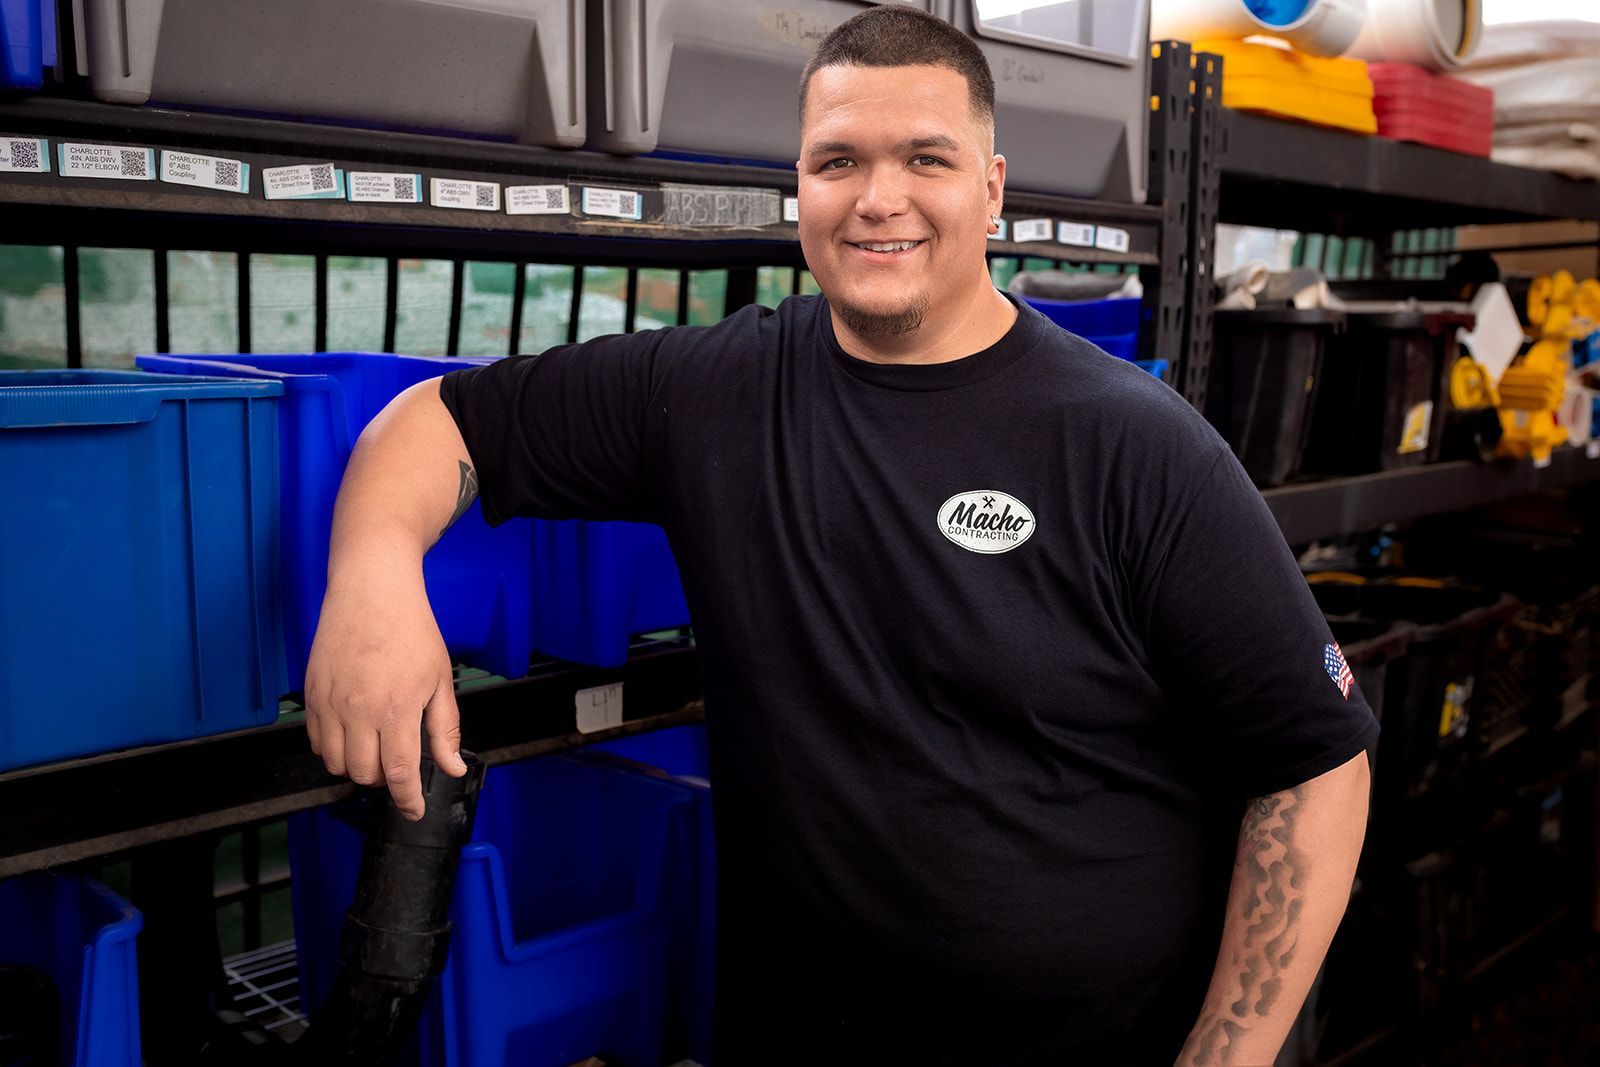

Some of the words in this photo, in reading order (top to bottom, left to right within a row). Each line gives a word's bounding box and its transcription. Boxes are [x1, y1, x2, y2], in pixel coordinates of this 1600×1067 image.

[70, 147, 112, 156] CHARLOTTE
[169, 154, 210, 166] CHARLOTTE
[169, 169, 196, 180] Coupling
[269, 169, 300, 177] CHARLOTTE
[665, 190, 709, 225] ABS
[948, 501, 1031, 532] Macho
[947, 526, 1019, 541] CONTRACTING
